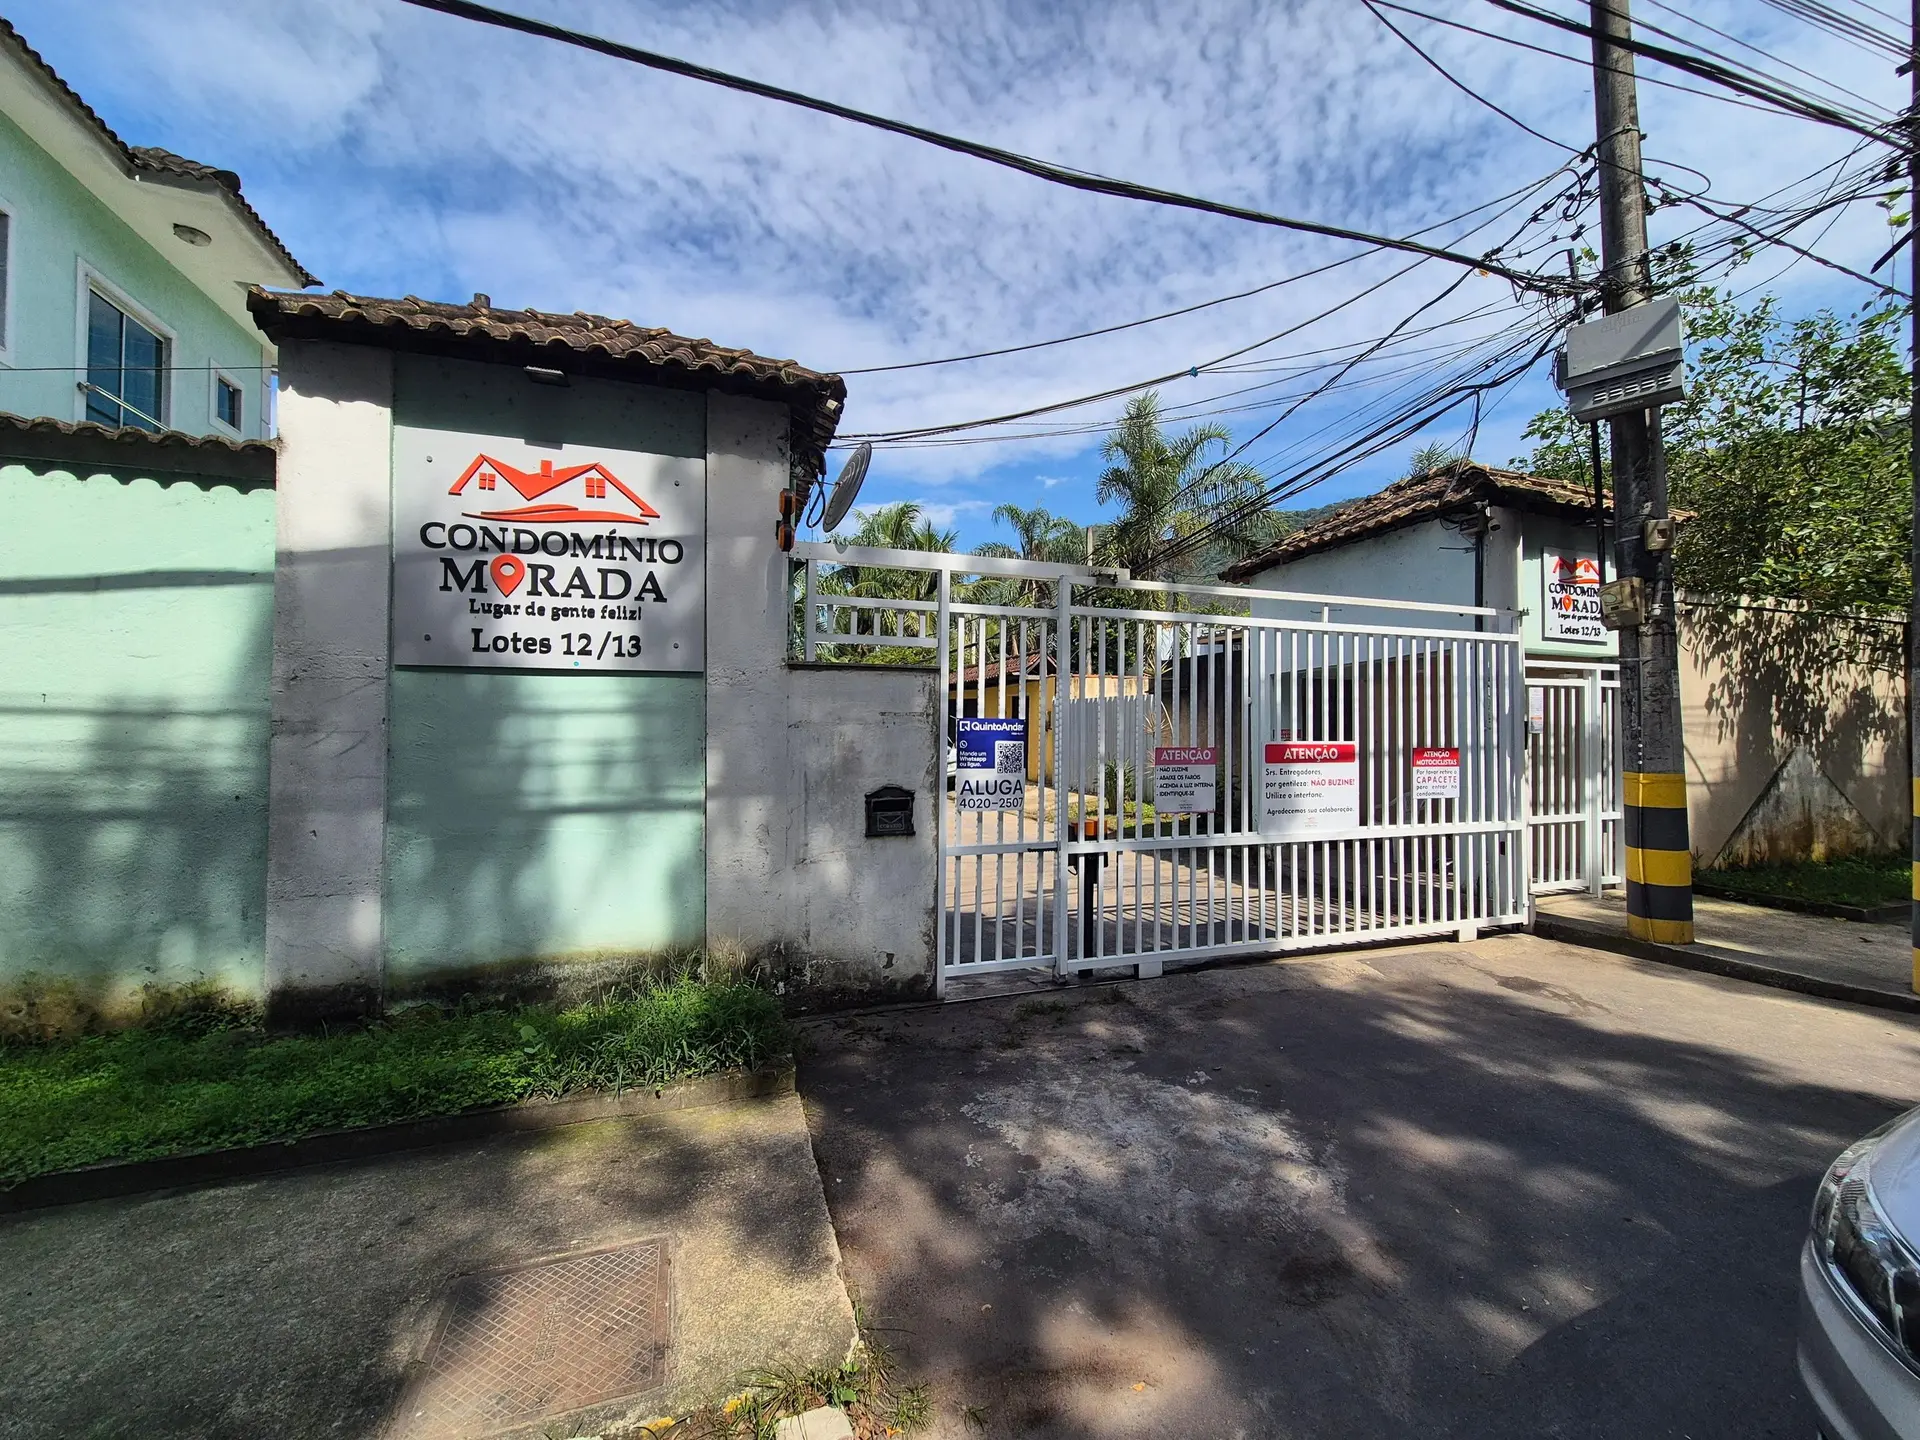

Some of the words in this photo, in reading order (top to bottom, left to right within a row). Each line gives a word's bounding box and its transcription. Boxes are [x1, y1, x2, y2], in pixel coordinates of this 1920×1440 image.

[420, 522, 684, 564] CONDOMÍNIO
[1549, 583, 1600, 597] CONDOMÍN
[469, 599, 520, 620] Lugar
[526, 601, 545, 616] de
[551, 605, 595, 621] gente
[601, 604, 642, 621] feliz!
[1560, 624, 1580, 635] Lotes
[1581, 625, 1601, 637] 12/13
[471, 628, 551, 654] Lotes
[561, 631, 642, 660] 12/13
[971, 721, 1024, 732] QuintoAndar
[1161, 748, 1211, 763] ATENÇÃO
[1284, 744, 1338, 763] ATENÇÃO
[1423, 750, 1450, 758] ATENÇÃO
[1265, 768, 1278, 776] Srs.
[960, 780, 1023, 796] ALUGA
[1311, 777, 1326, 786] NÃO
[960, 797, 1024, 809] 4020-2507
[1267, 808, 1306, 816] Agradecemos
